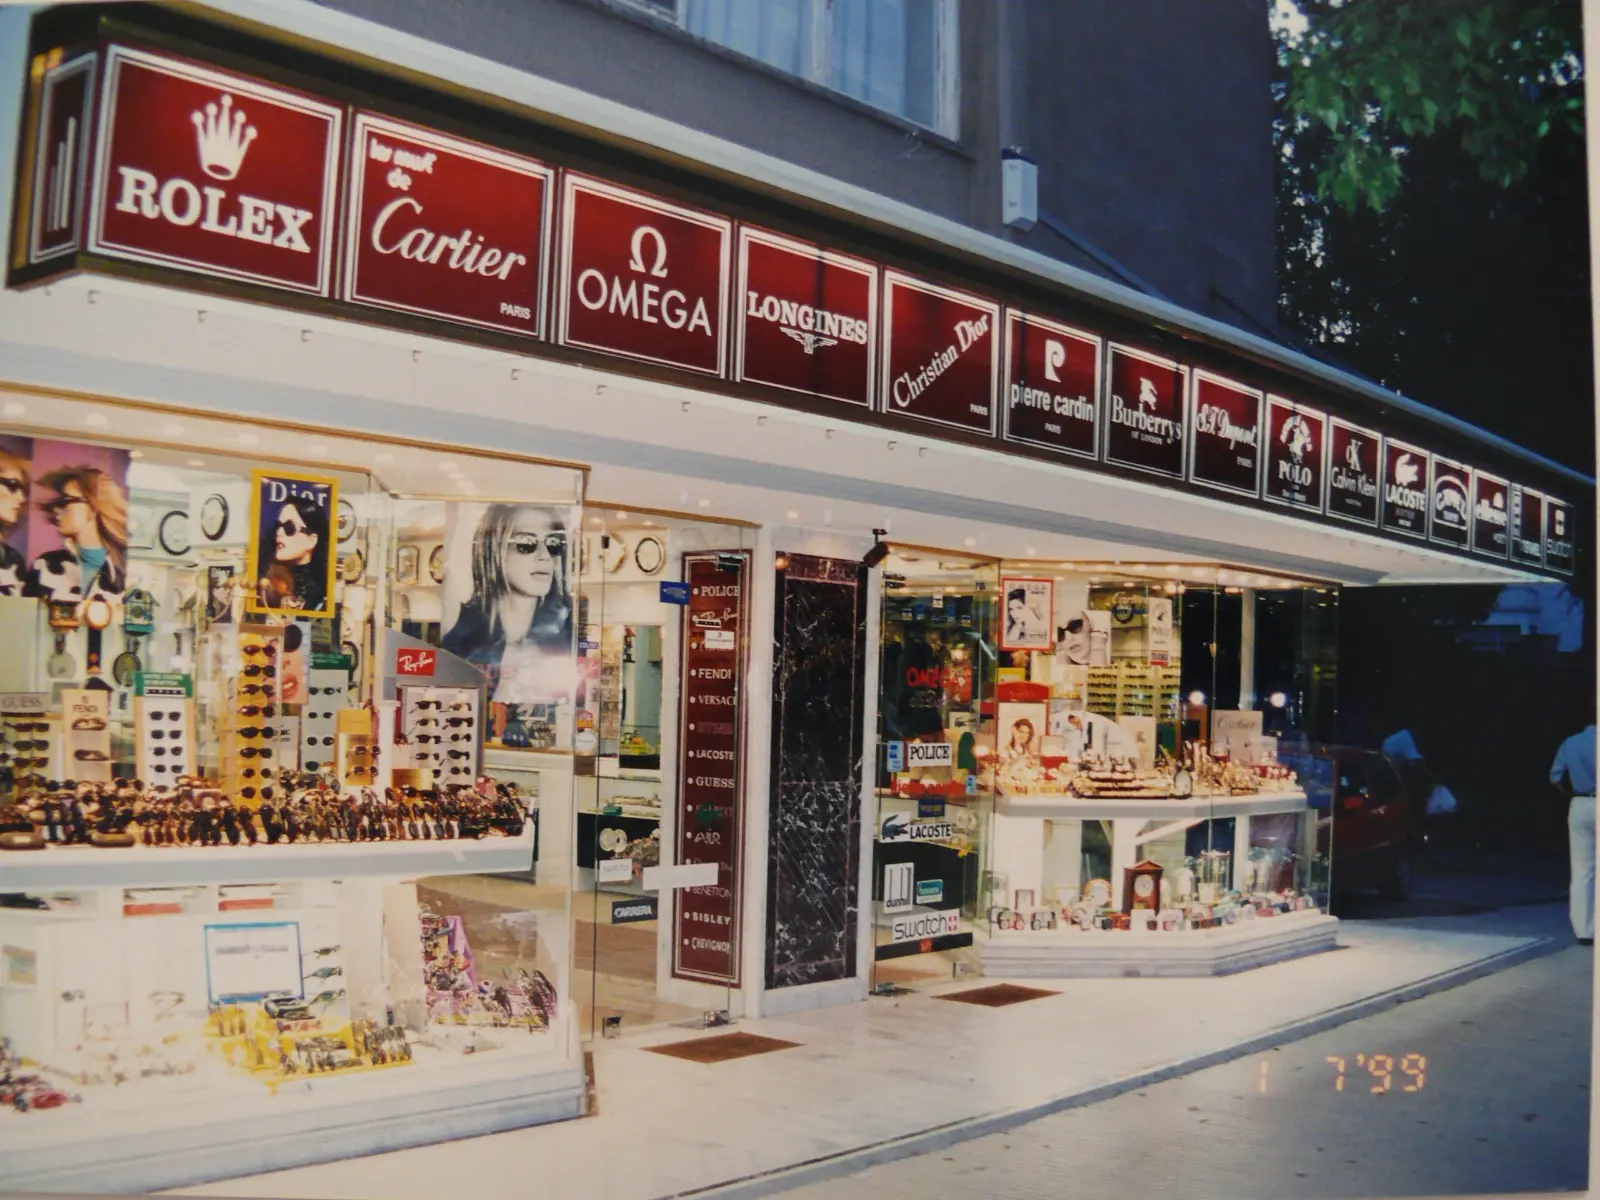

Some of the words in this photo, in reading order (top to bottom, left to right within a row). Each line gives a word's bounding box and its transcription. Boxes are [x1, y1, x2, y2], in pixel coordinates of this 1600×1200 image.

[115, 166, 313, 254] ROLEX
[371, 197, 527, 281] Cartier
[500, 302, 532, 320] PARIS
[577, 268, 712, 337] OMEGA
[747, 290, 868, 345] LONGINES
[893, 344, 959, 409] Christian
[953, 314, 990, 353] Dior
[1010, 380, 1051, 412] pierre
[1053, 391, 1094, 423] cardin
[1112, 394, 1182, 444] Burberrys
[1278, 459, 1312, 487] POLO
[1331, 466, 1357, 492] Calvin
[269, 481, 328, 508] Dior
[1385, 483, 1427, 512] LACOSTE
[701, 585, 740, 597] POLICE
[399, 651, 434, 672] Ray-Ban
[699, 668, 732, 680] FENDI
[696, 749, 734, 760] LACOSTE
[909, 745, 950, 760] POLICE
[695, 776, 735, 789] GUESS
[910, 824, 952, 840] LACOSTE
[691, 911, 732, 925] SISLEY
[894, 913, 948, 940] swatch
